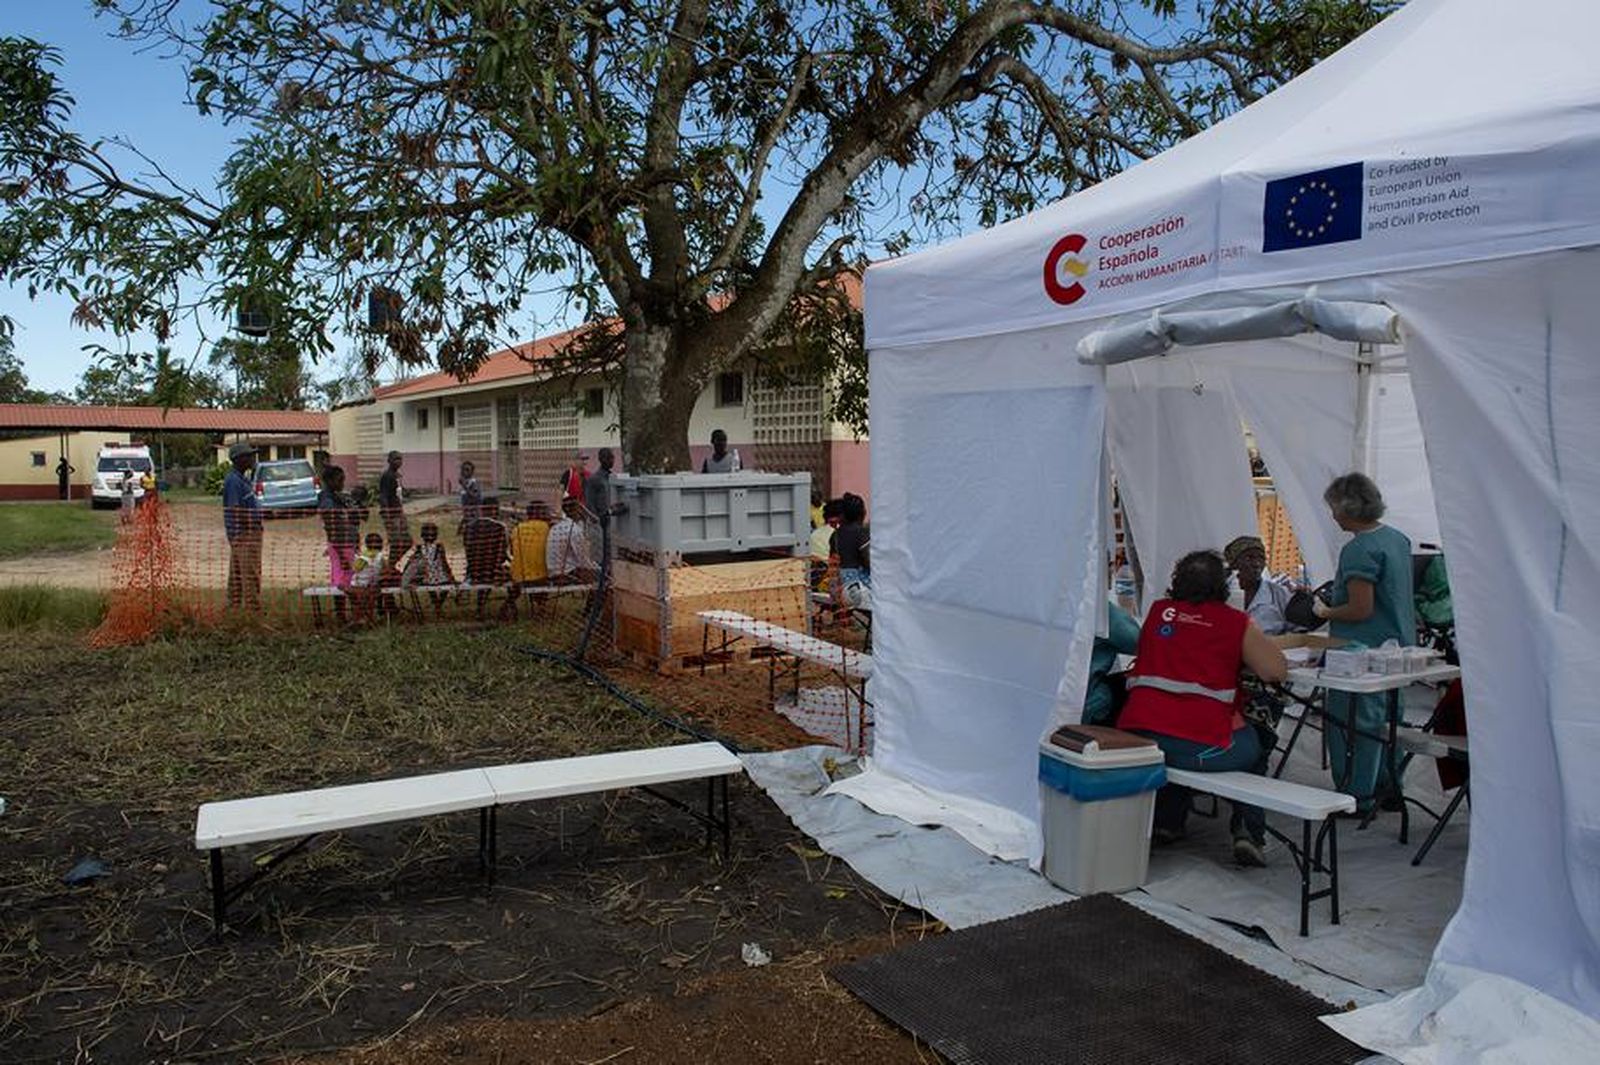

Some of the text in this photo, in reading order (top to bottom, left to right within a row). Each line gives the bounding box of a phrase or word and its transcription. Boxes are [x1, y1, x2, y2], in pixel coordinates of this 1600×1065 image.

[1369, 171, 1461, 197] European Union
[1368, 185, 1469, 213] Humanitarian Aid
[1368, 204, 1480, 230] and Civil Protection
[1099, 215, 1185, 250] Cooperación
[1099, 245, 1159, 273] Española
[1136, 254, 1207, 281] HUMANITARIA
